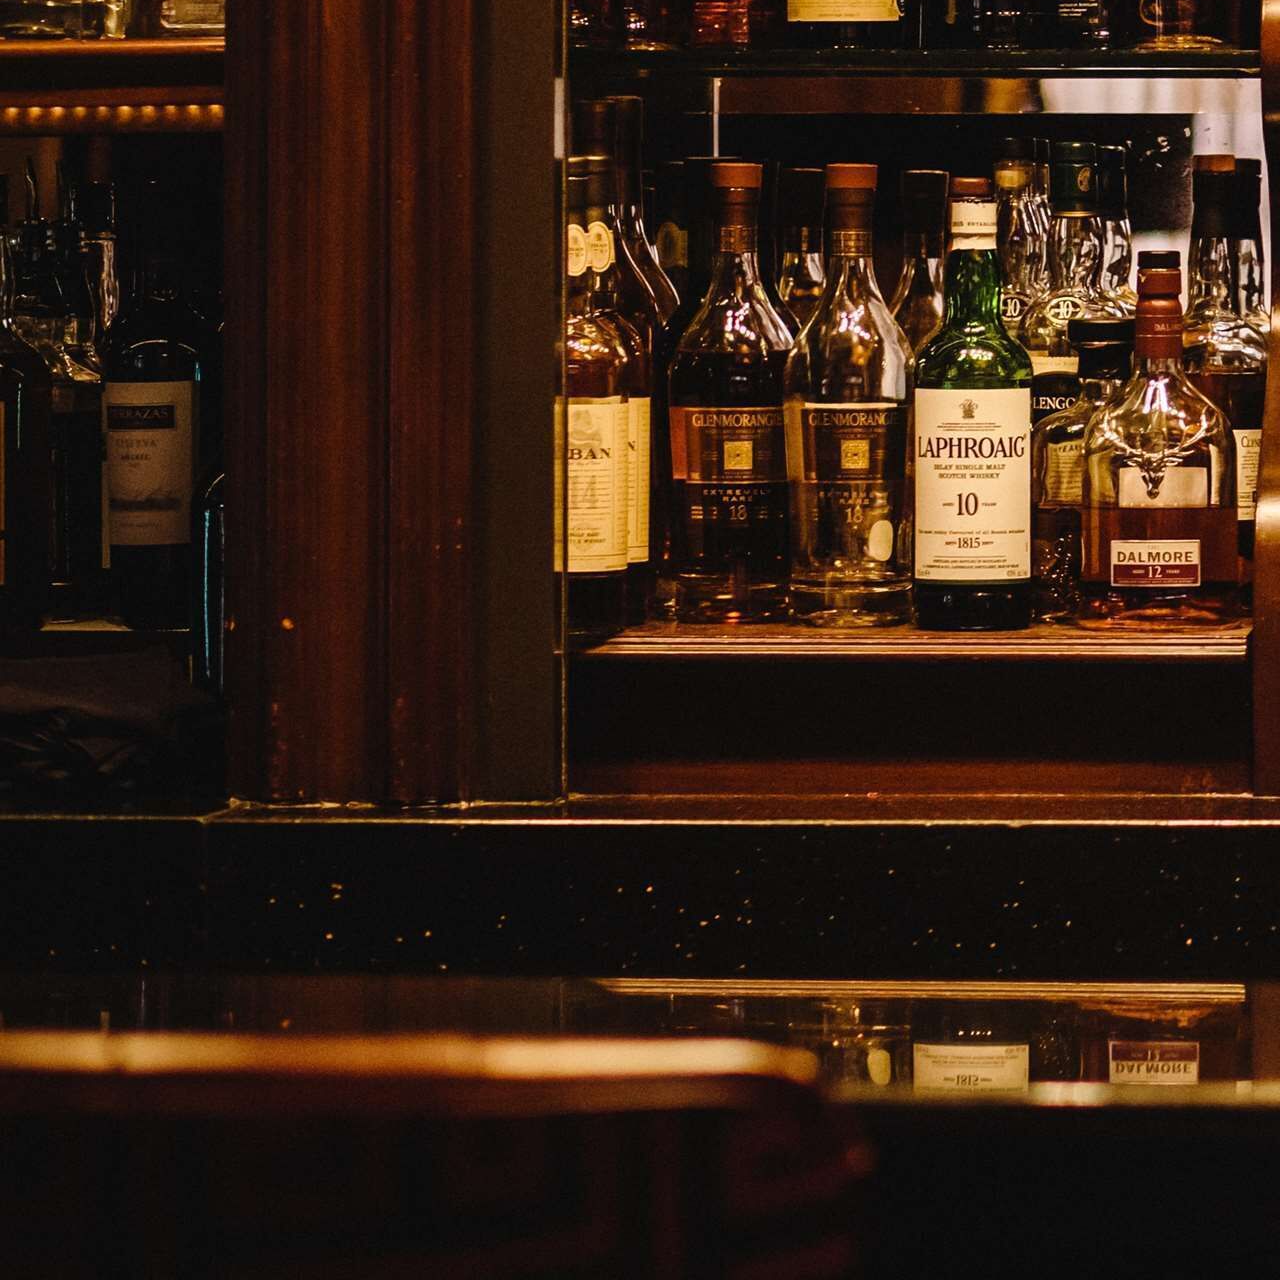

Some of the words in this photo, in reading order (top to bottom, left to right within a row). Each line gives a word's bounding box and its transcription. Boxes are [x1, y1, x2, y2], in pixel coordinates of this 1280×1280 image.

[1006, 298, 1020, 317] 10
[1058, 300, 1072, 319] 10
[918, 436, 1025, 458] LAPHROAIG
[938, 472, 968, 480] SCOTCH
[970, 472, 1000, 480] WHISKY
[729, 504, 747, 521] 18
[956, 491, 979, 517] 10
[846, 505, 865, 523] 18
[957, 537, 981, 549] 1815
[1117, 550, 1194, 563] DALMORE
[1147, 565, 1163, 578] 12
